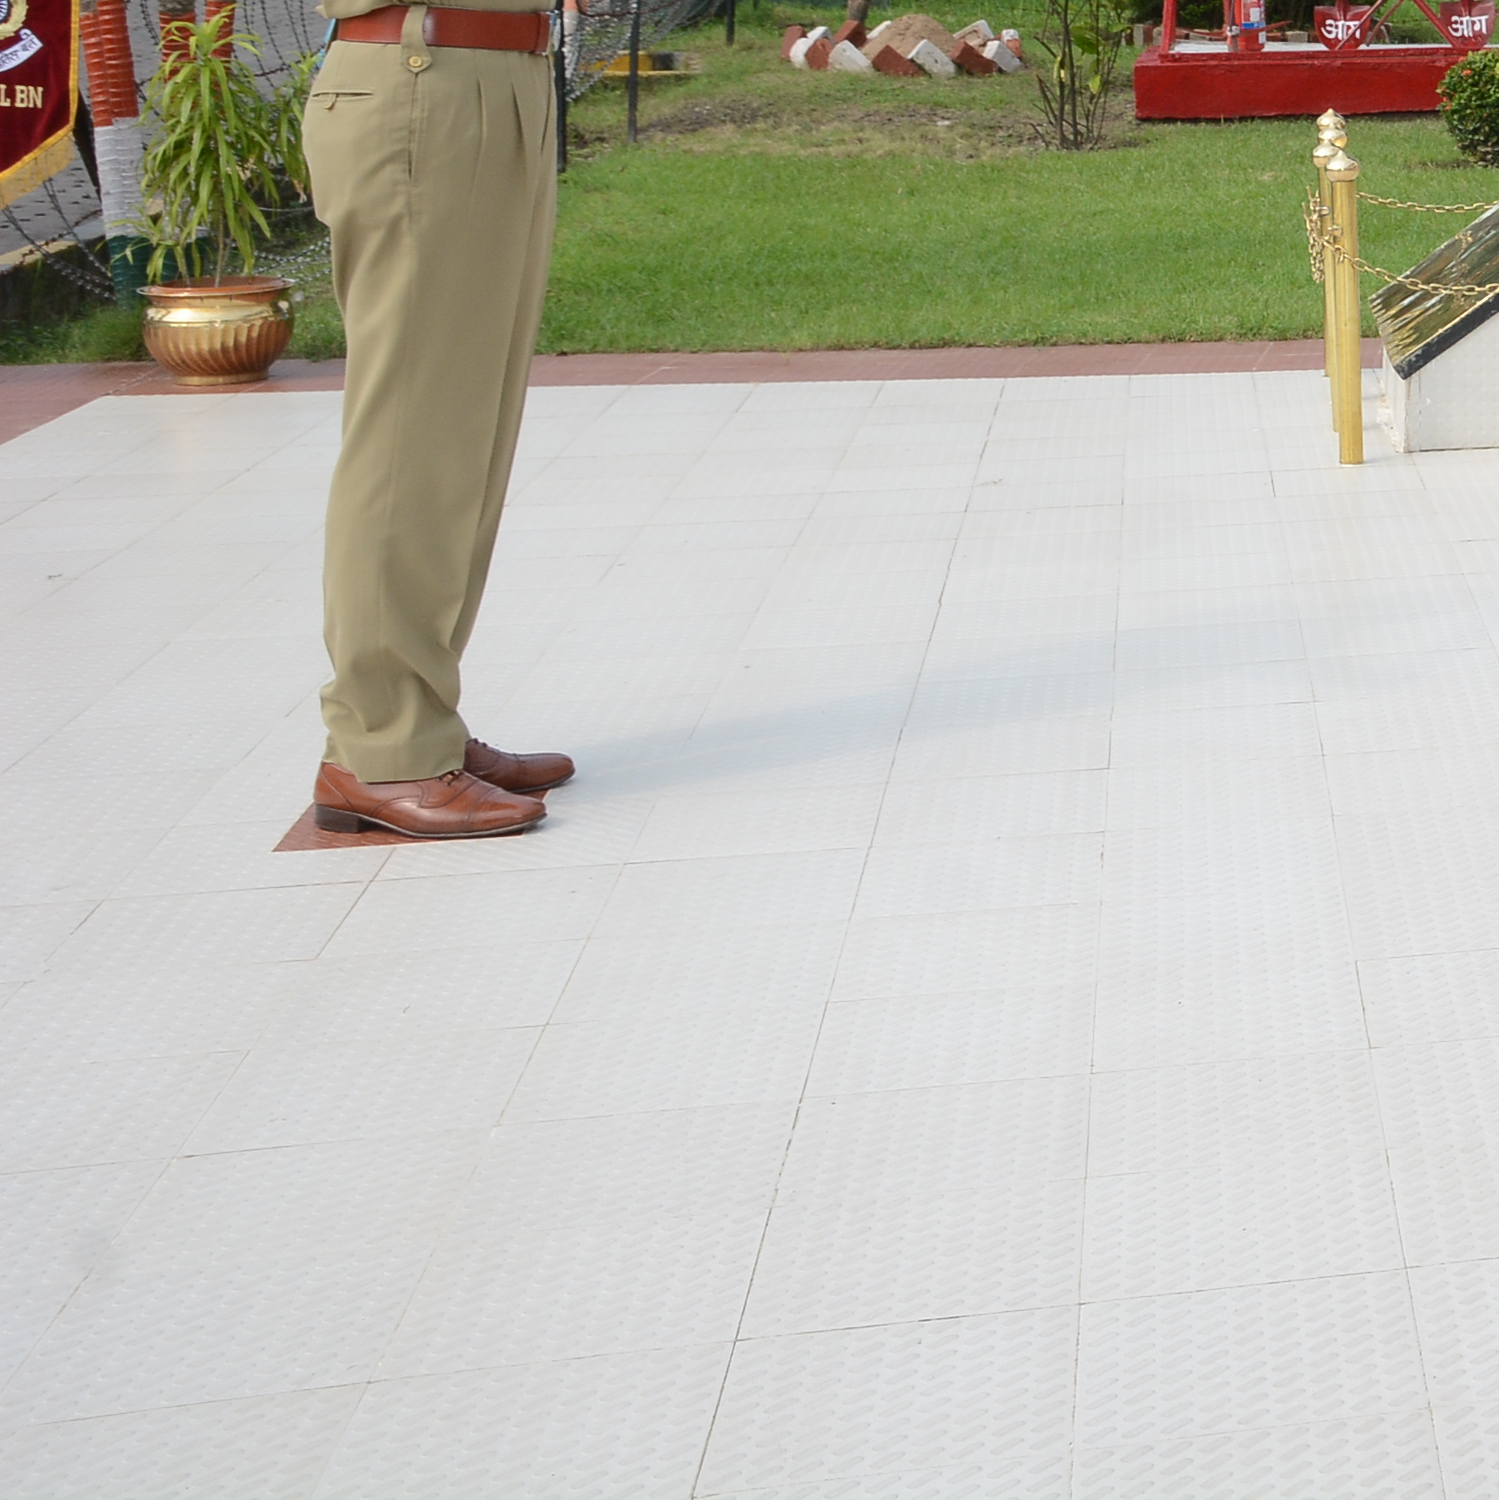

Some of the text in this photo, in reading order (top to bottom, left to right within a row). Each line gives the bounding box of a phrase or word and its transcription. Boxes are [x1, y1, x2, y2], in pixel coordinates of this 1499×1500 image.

[1321, 18, 1361, 41] आग
[1449, 14, 1489, 38] आग
[0, 83, 44, 108] L BN
